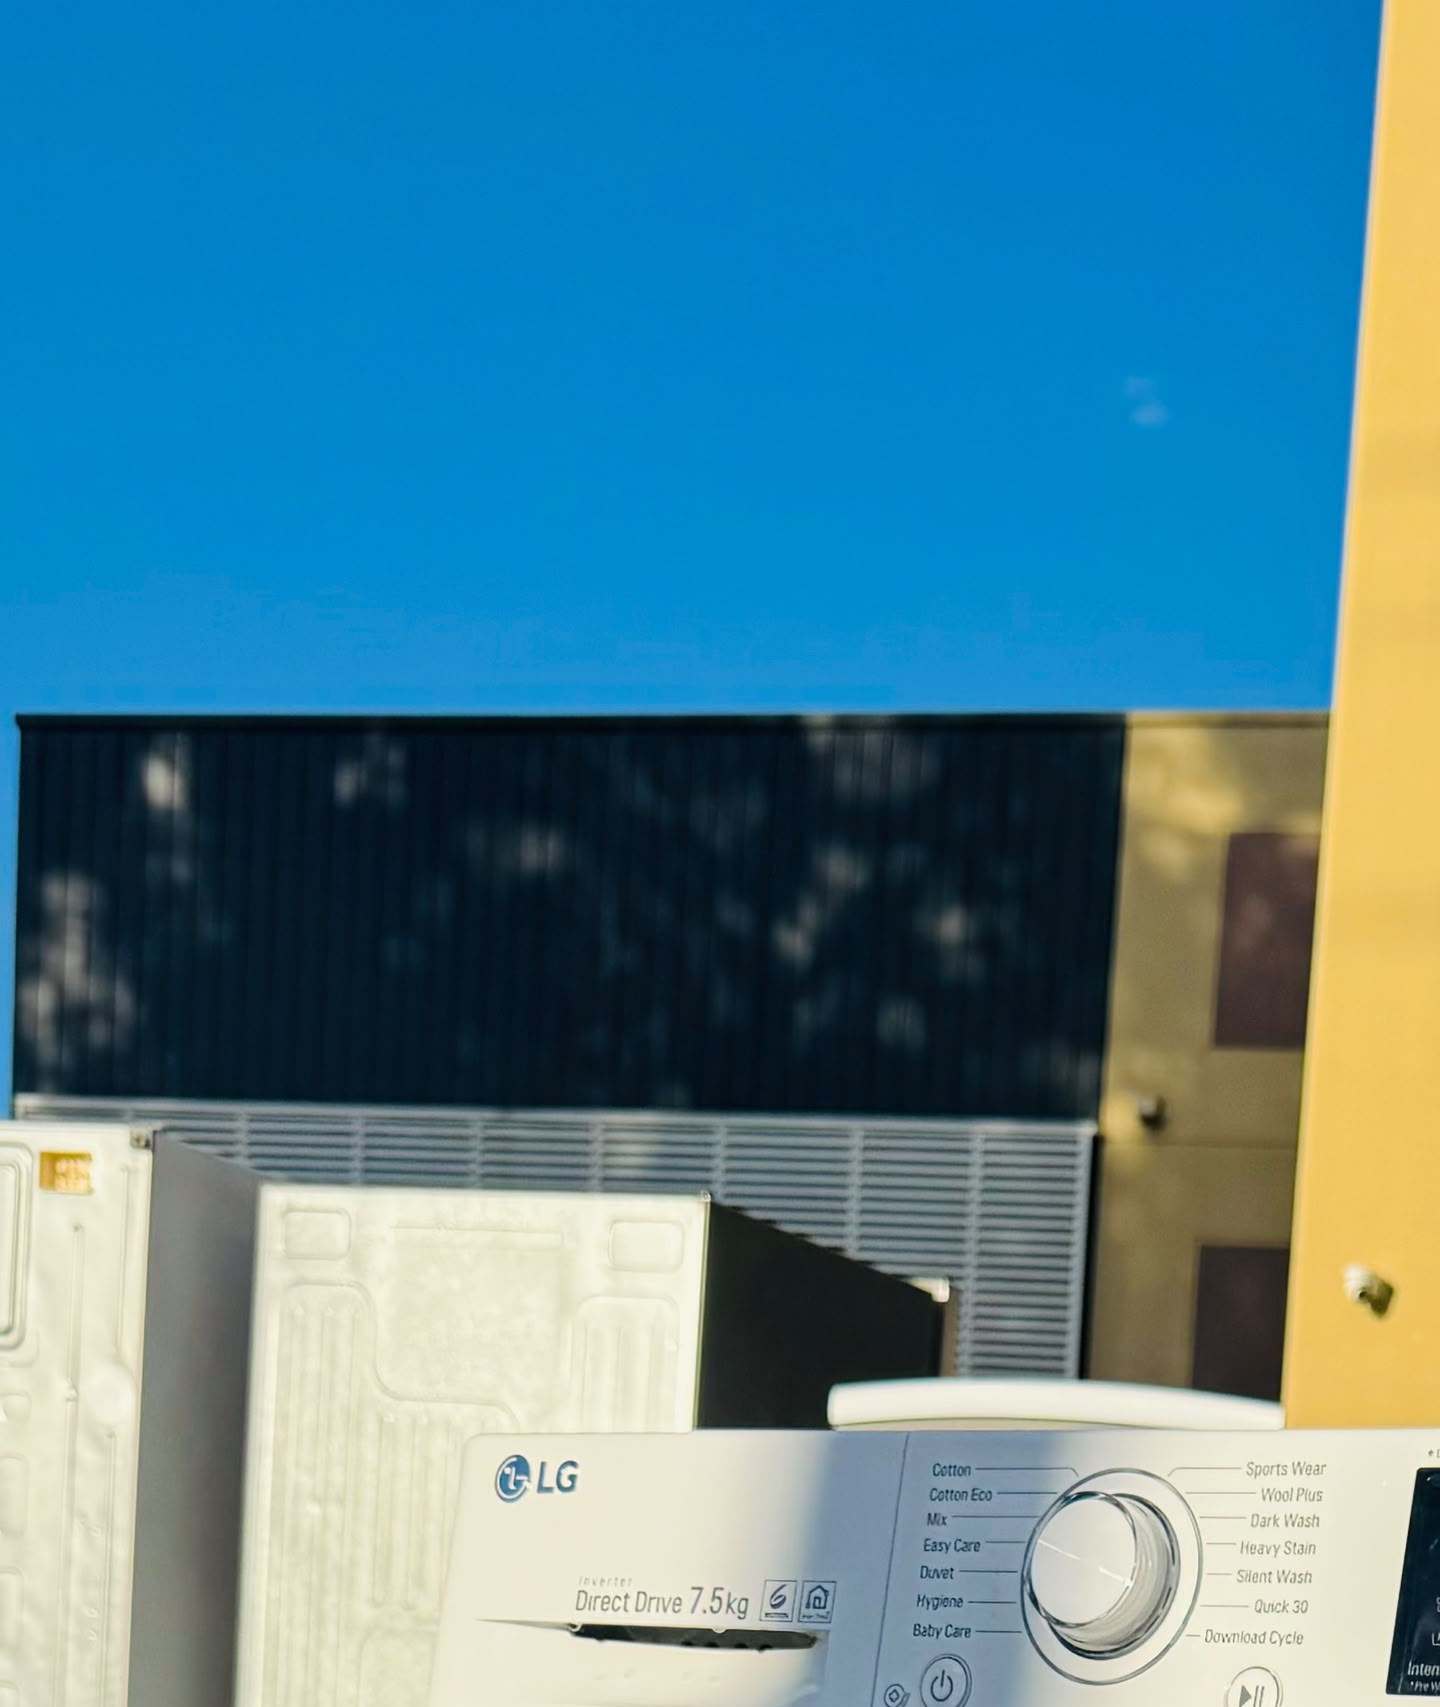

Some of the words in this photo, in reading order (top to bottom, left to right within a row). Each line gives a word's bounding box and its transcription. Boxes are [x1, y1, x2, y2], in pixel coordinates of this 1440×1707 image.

[537, 1460, 579, 1494] LG
[932, 1463, 972, 1477] Cotton
[1246, 1461, 1288, 1479] Sports
[1291, 1461, 1327, 1476] Wear
[929, 1487, 969, 1502] Cotton
[970, 1487, 993, 1502] Eco
[1261, 1487, 1293, 1502] Wool
[1296, 1487, 1323, 1502] Plus
[926, 1512, 948, 1527] Mix
[1250, 1513, 1280, 1528] Dark
[1284, 1513, 1320, 1528] Wash
[923, 1538, 951, 1555] Easy
[953, 1538, 981, 1553] Care
[1240, 1540, 1281, 1558] Heavy
[1283, 1540, 1316, 1555] Stain
[920, 1565, 955, 1580] Duvet
[1236, 1569, 1273, 1584] Silent
[1276, 1569, 1313, 1584] Wash
[578, 1575, 633, 1588] Inverter
[575, 1589, 629, 1613] Direct
[635, 1590, 683, 1614] Drive
[916, 1594, 964, 1611] Hygiene
[1254, 1598, 1290, 1614] Quick
[1292, 1599, 1309, 1614] 30
[912, 1623, 943, 1640] Baby
[944, 1624, 972, 1639] Care
[1204, 1628, 1267, 1645] Download
[1269, 1630, 1304, 1647] Cycle
